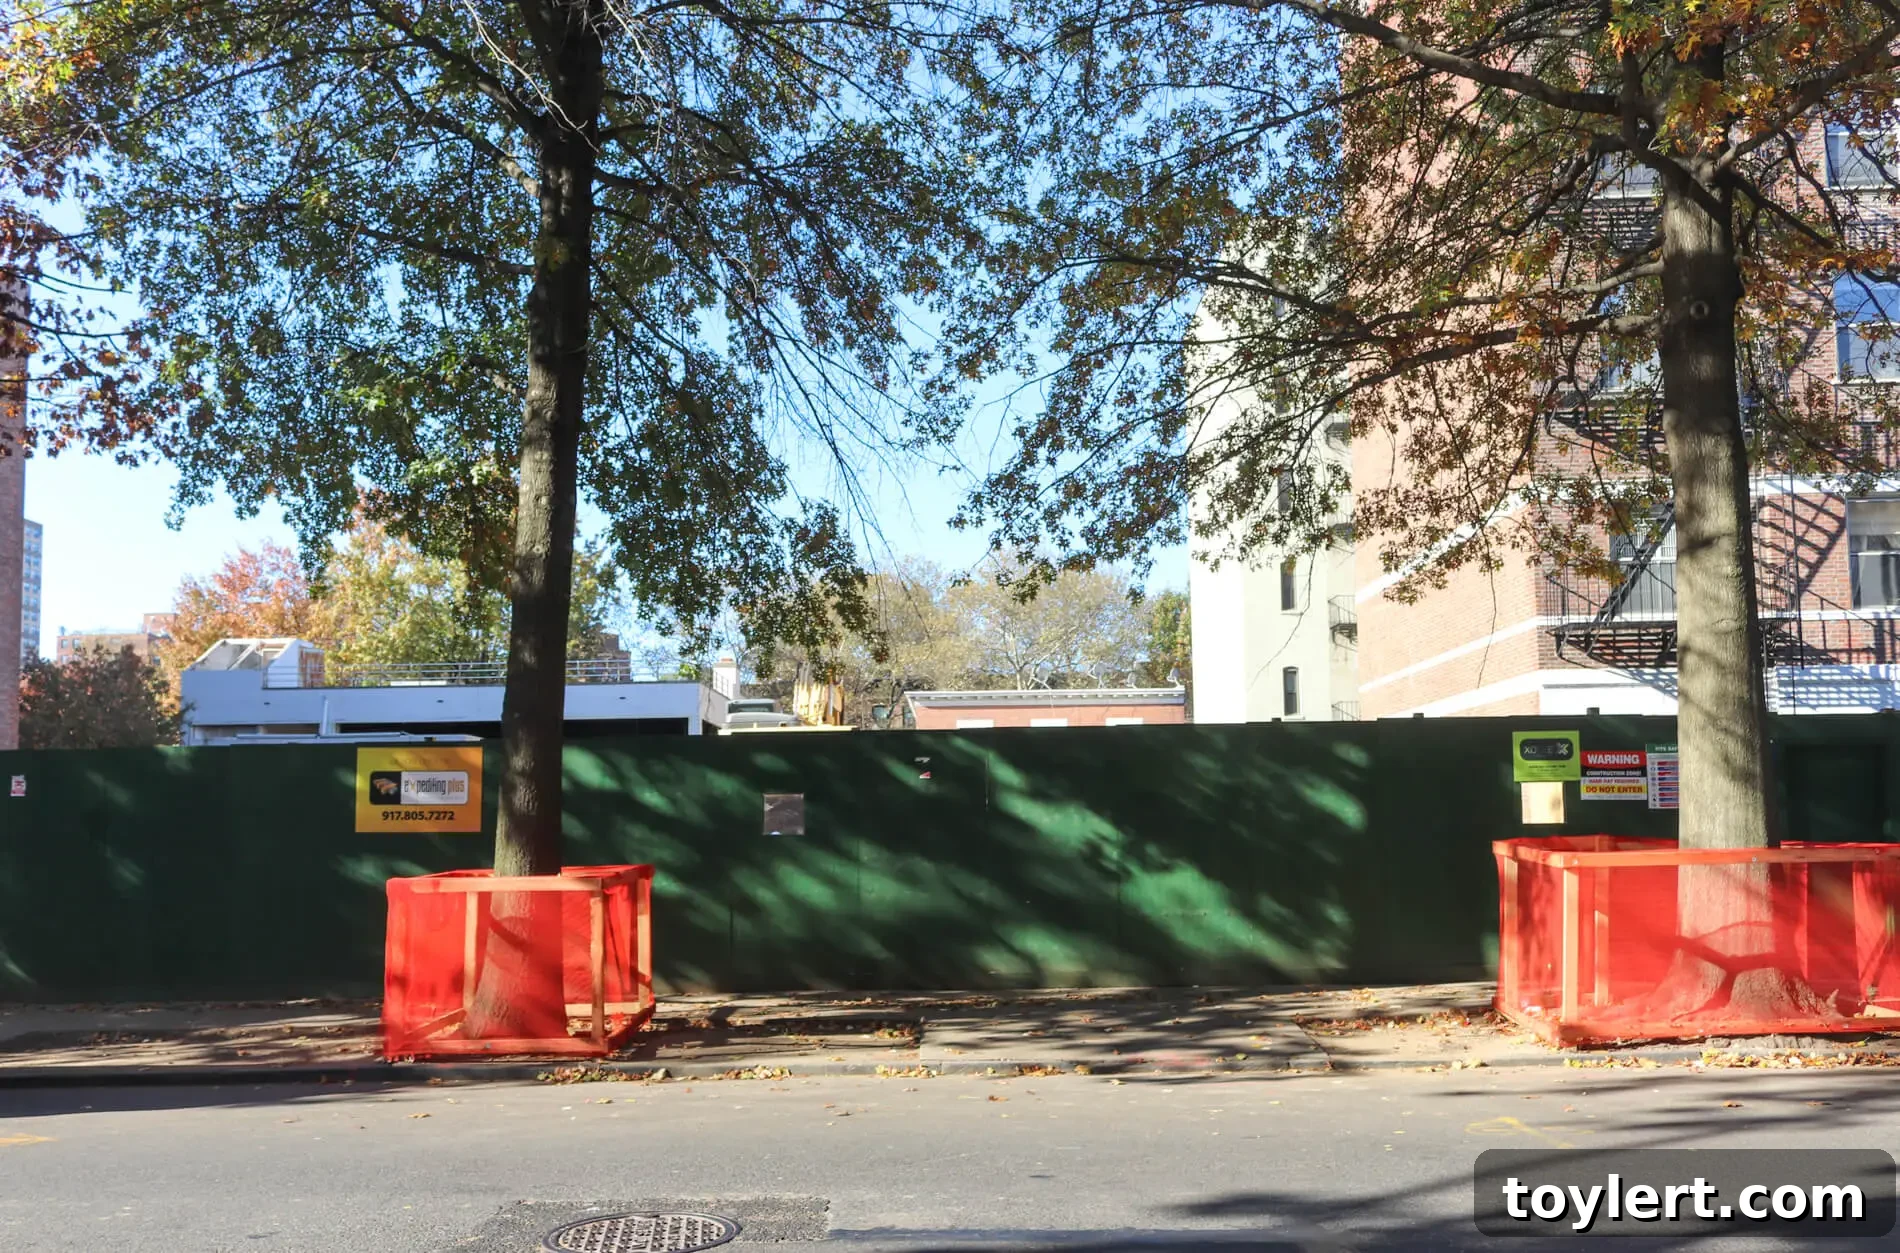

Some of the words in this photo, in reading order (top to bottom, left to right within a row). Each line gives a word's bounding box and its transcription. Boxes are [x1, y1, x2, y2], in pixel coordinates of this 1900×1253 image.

[1587, 754, 1640, 764] WARNING
[447, 778, 465, 795] plus
[382, 811, 455, 821] 917.805.7272
